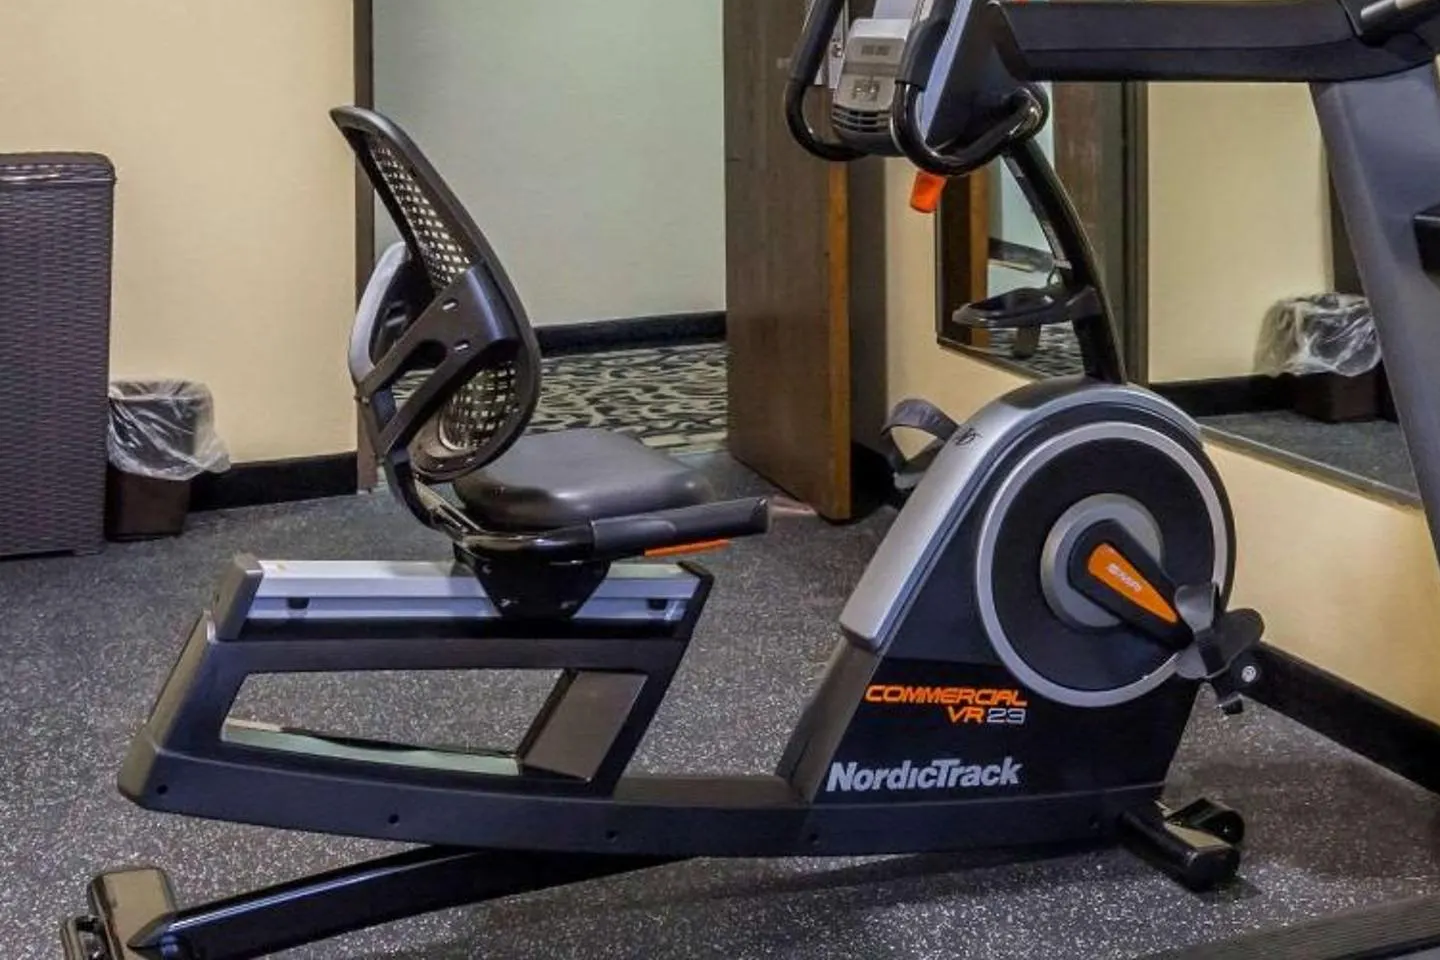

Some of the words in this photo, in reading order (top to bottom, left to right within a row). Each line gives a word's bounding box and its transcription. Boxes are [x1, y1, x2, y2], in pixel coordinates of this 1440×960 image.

[865, 685, 1028, 707] COMMERCIAL
[948, 706, 986, 724] VR
[986, 707, 1026, 724] 23
[826, 756, 1024, 792] NordicTrack
